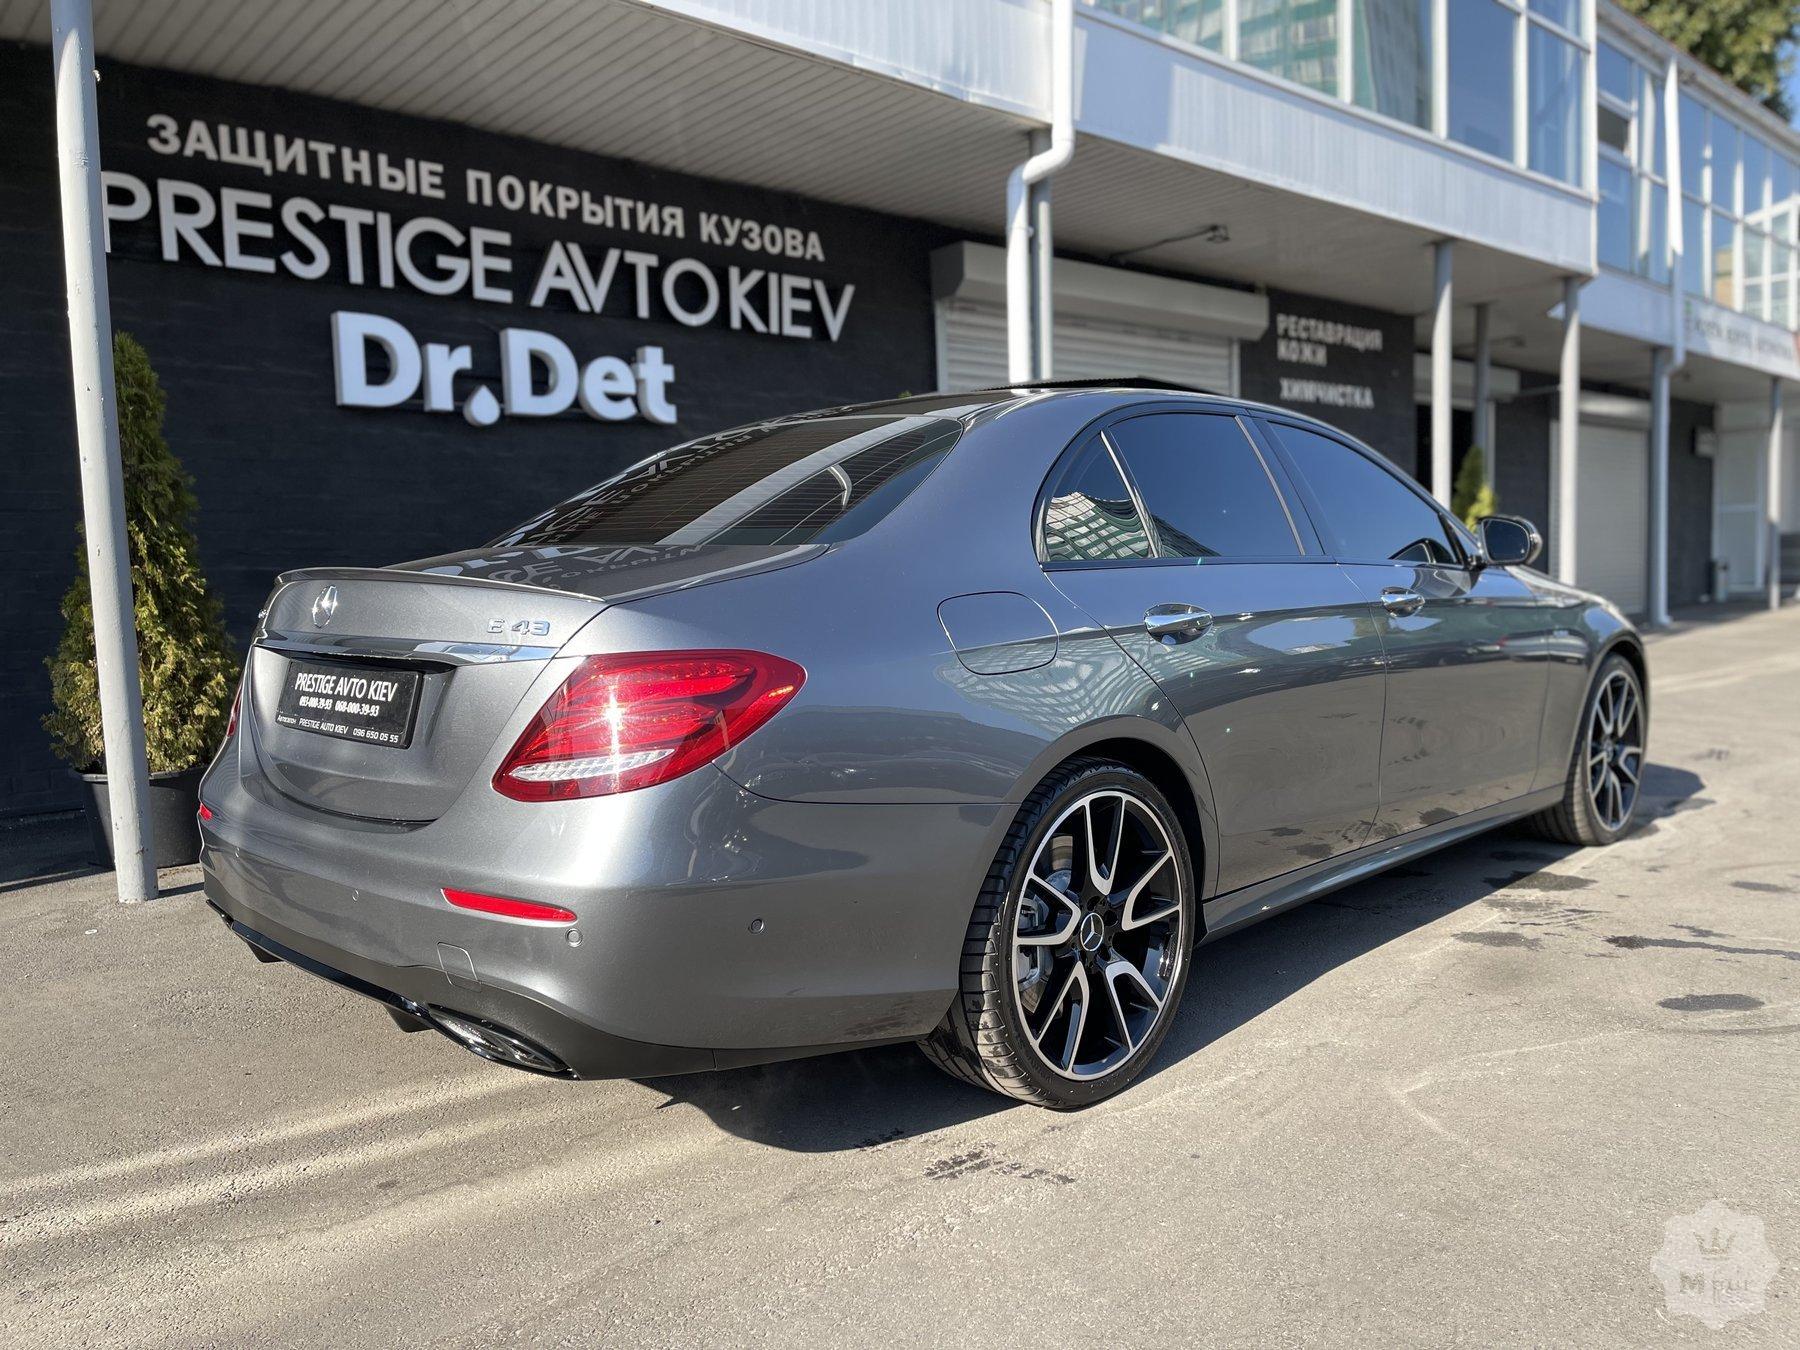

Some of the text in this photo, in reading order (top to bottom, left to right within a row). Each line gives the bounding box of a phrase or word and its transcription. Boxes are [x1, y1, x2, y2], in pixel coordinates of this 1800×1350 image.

[147, 114, 825, 262] ЗАЩИТНЫЕ ПОКРЫТИЯ КУЗОВА
[100, 170, 514, 304] PRESTIGE
[486, 618, 551, 636] E 43
[294, 672, 398, 702] PRESTIGE AVTO KIEV
[299, 717, 320, 730] PRESTIGE
[334, 725, 349, 735] KIEV
[353, 727, 366, 738] 096
[366, 730, 379, 740] 650
[379, 732, 389, 741] 05
[389, 733, 399, 743] 55
